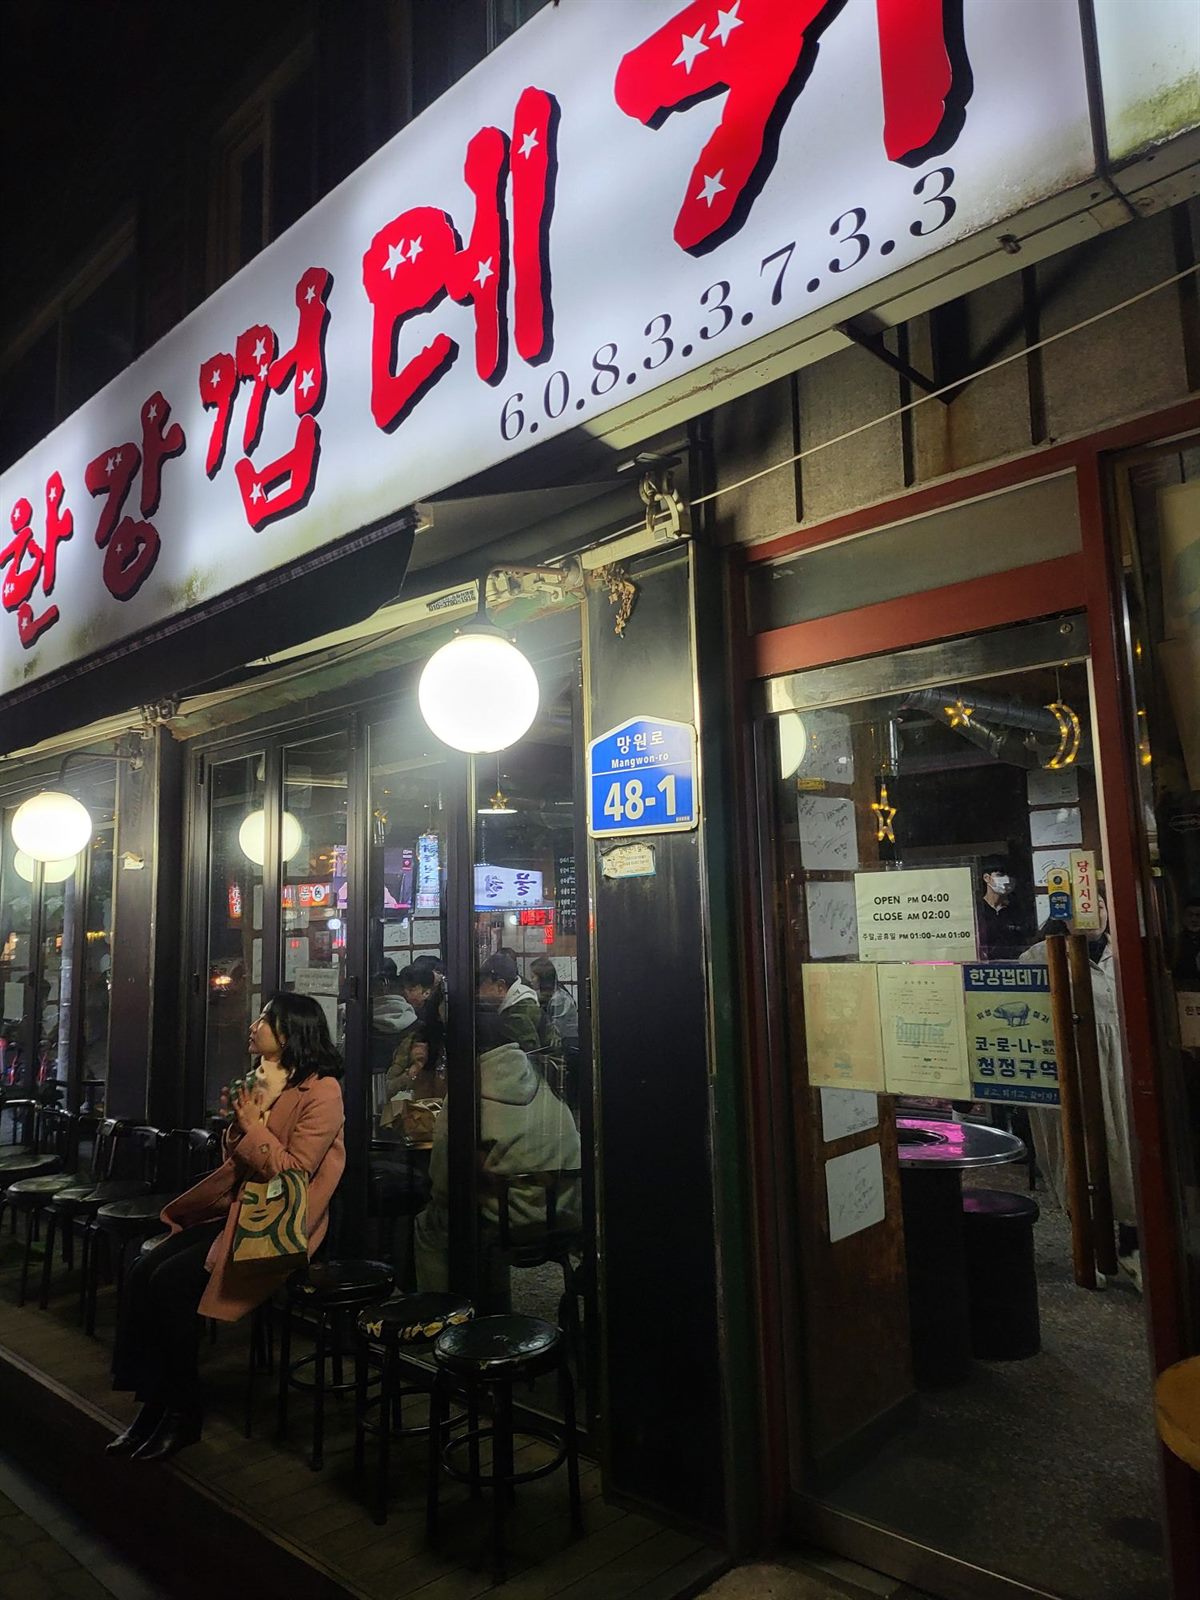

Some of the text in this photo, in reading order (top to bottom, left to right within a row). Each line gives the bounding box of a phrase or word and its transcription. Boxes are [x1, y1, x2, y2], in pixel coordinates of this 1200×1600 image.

[499, 166, 957, 442] 6.0.8.3.3.7.3.3
[616, 730, 665, 755] 망원로
[611, 753, 669, 769] Mangwon-ro
[603, 774, 676, 822] 48-1
[1077, 860, 1093, 913] 당기시오
[873, 896, 901, 905] OPEN
[920, 893, 950, 903] 04:00
[873, 910, 951, 921] CLOSE AM 02:00
[947, 931, 971, 939] 01:00
[969, 968, 1048, 986] 한강껍데기
[978, 1057, 1058, 1080] 청정구역
